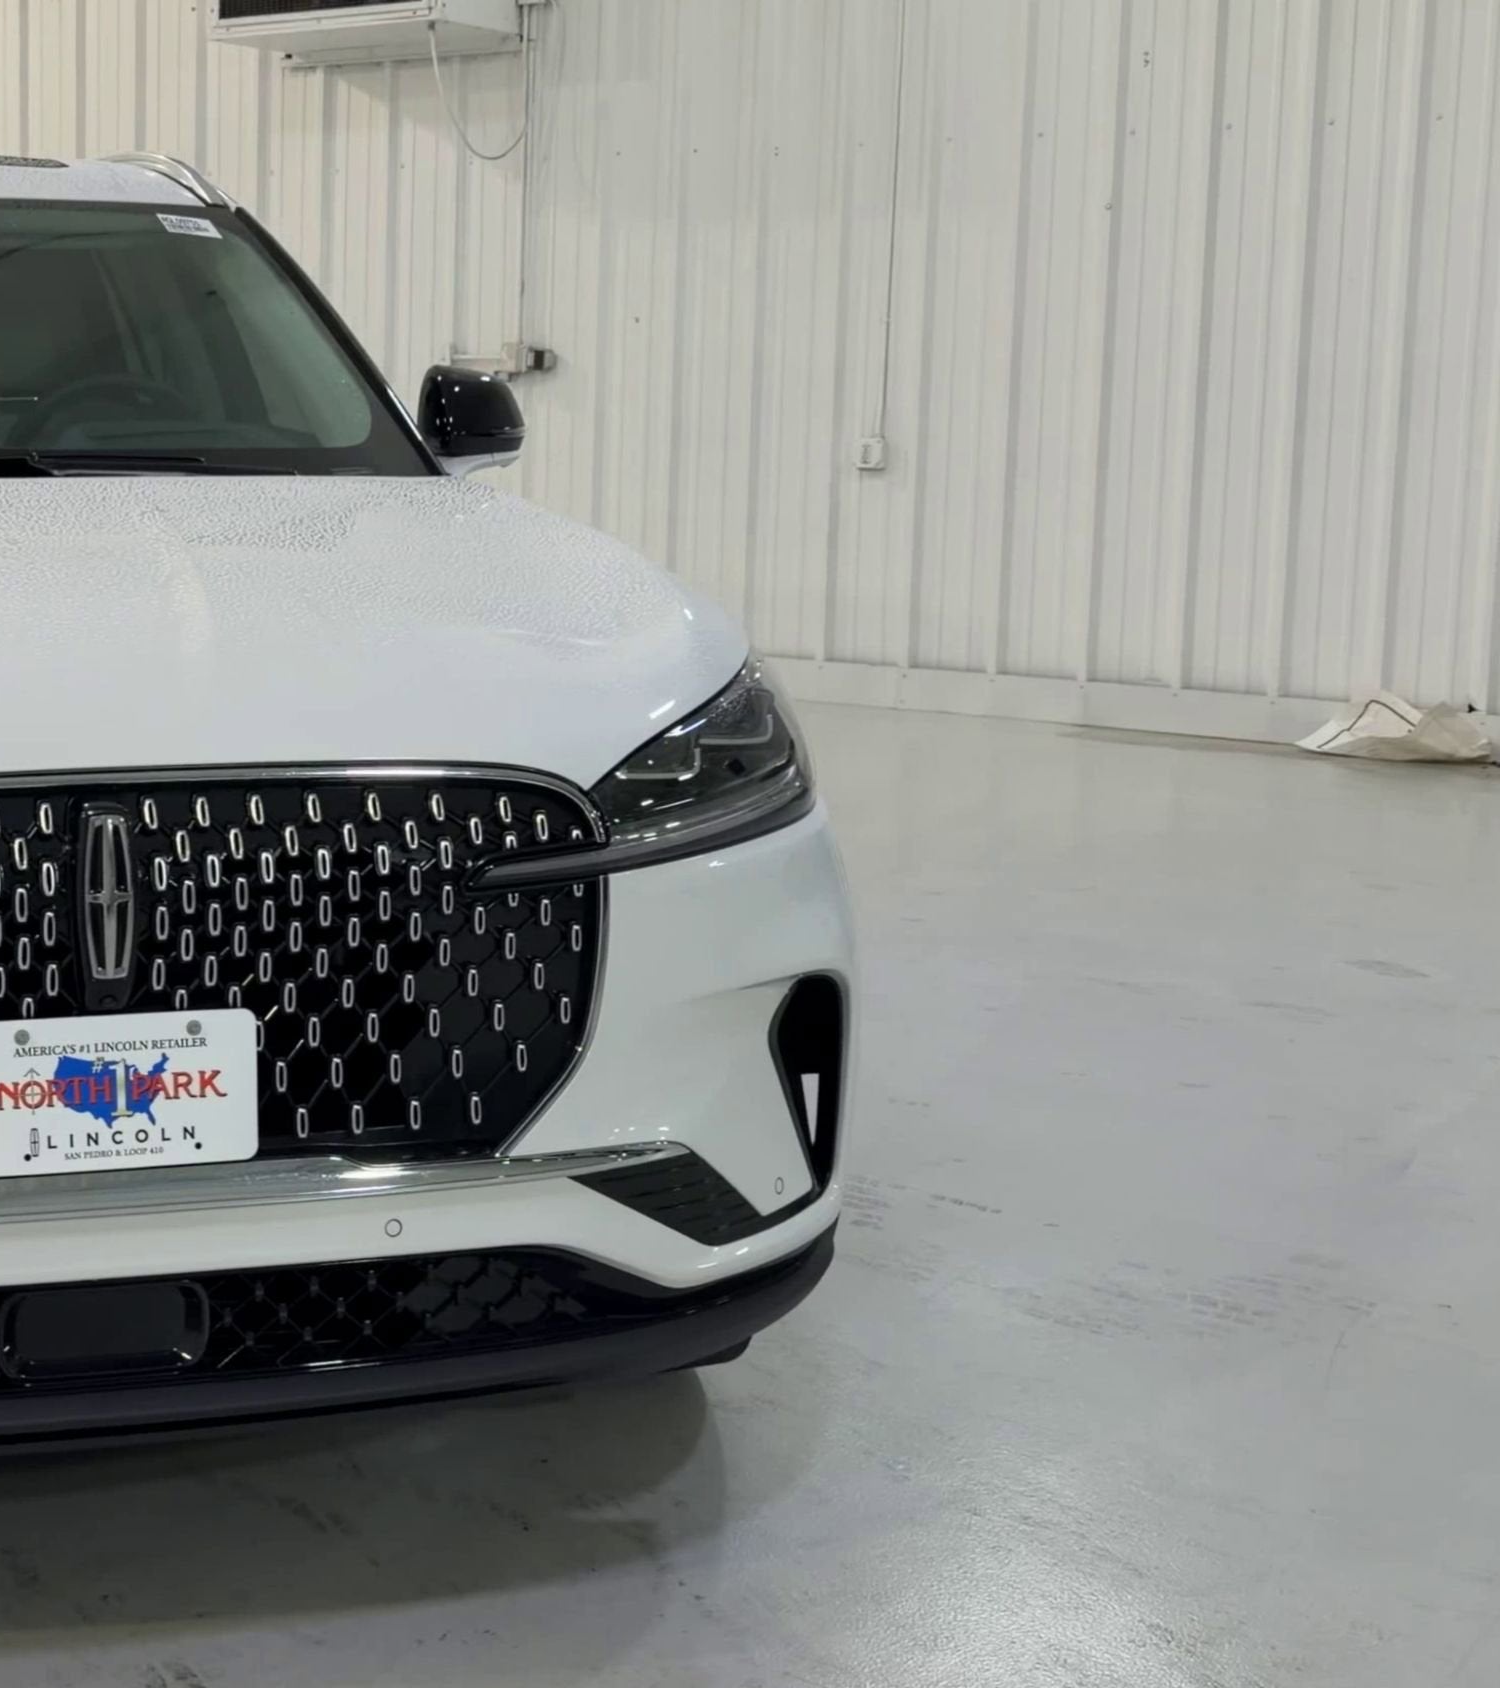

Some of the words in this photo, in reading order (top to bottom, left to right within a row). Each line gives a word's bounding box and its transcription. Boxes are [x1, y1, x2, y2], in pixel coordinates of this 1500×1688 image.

[13, 1044, 76, 1058] AMERICA'S
[78, 1043, 92, 1055] #1
[94, 1039, 149, 1054] LINCOLN
[151, 1037, 208, 1050] RETAILER
[131, 1069, 229, 1100] PARK
[46, 1126, 197, 1150] LINCOLN
[64, 1151, 82, 1161] SAN
[83, 1149, 114, 1160] PEDRO
[115, 1148, 122, 1157] &
[124, 1147, 149, 1157] LOOP
[150, 1145, 165, 1155] 410
